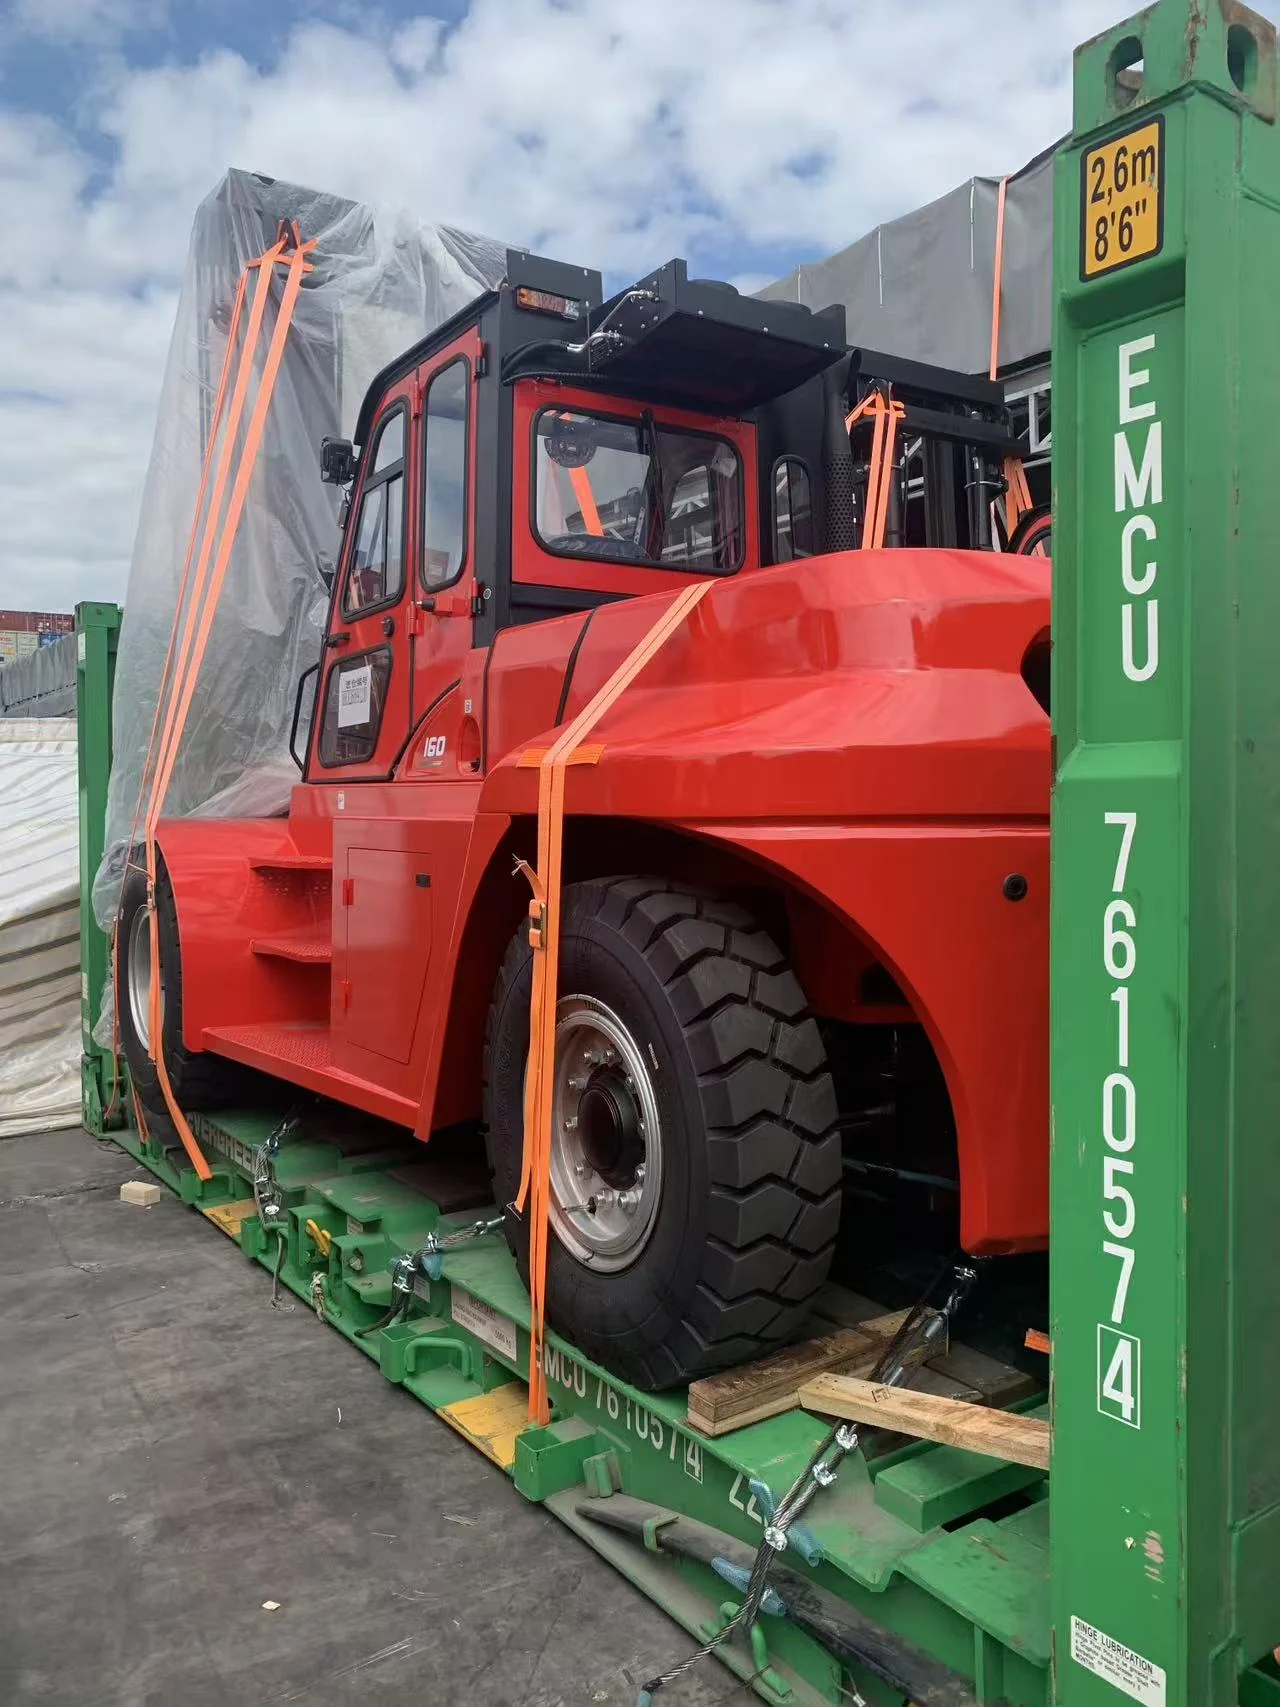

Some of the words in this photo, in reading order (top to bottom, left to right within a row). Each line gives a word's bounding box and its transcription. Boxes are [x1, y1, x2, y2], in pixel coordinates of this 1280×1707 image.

[1090, 144, 1156, 204] 2,6m
[1094, 199, 1147, 262] 8'6"
[1114, 333, 1163, 682] EMCU
[424, 735, 446, 758] 160
[1102, 811, 1137, 1325] 761057
[1103, 1338, 1135, 1421] 4
[1075, 1619, 1097, 1641] HINGE
[1102, 1636, 1153, 1675] LUBRICATION
